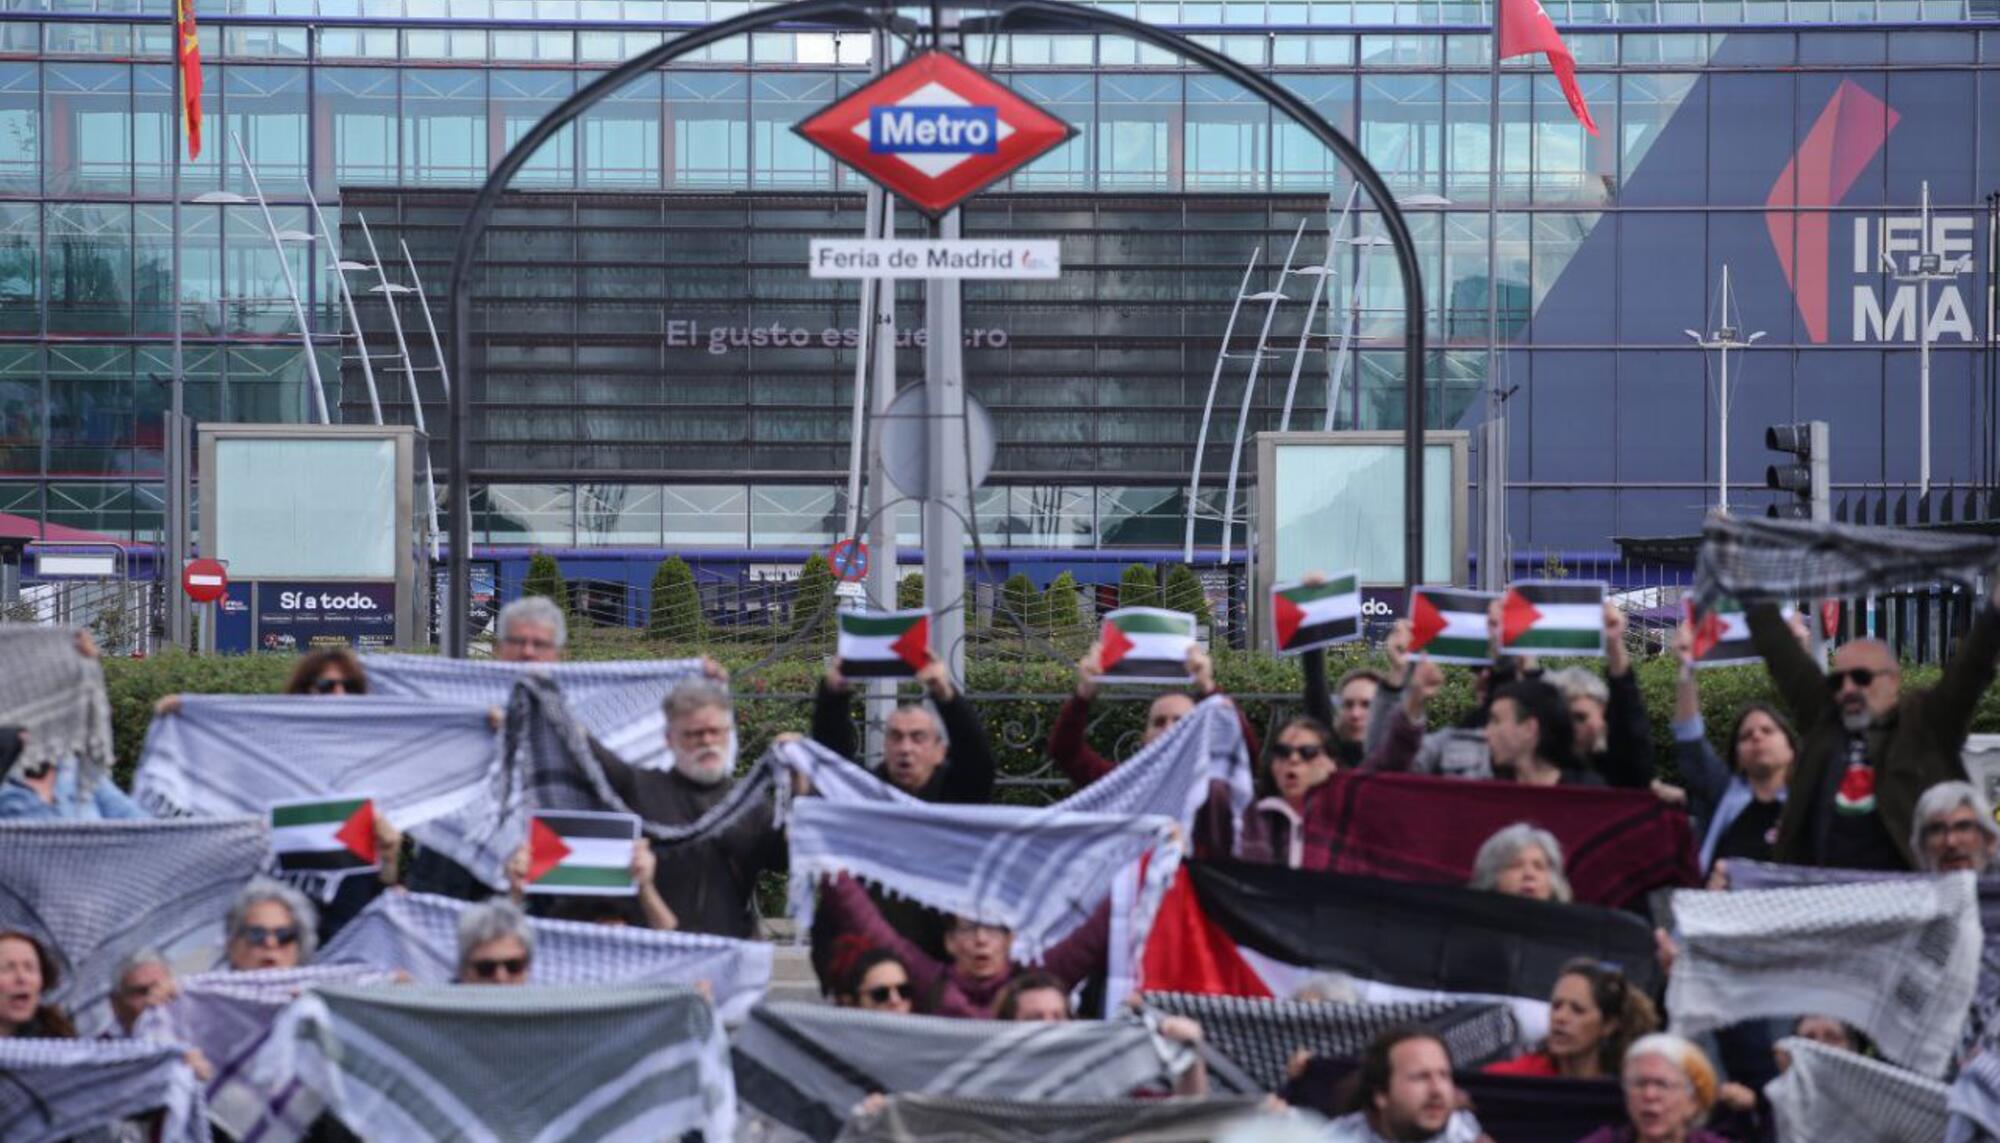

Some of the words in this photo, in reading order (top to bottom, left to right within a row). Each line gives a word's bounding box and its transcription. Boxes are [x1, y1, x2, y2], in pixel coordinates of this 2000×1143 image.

[881, 112, 988, 145] Metro
[819, 249, 879, 269] Feria
[888, 249, 918, 269] de
[927, 249, 1012, 269] Madrid
[1854, 217, 1996, 273] IFE
[1853, 285, 1996, 342] MA
[667, 320, 696, 346] El
[708, 322, 809, 354] gusto
[821, 327, 860, 347] es
[280, 591, 303, 609] Sí
[304, 597, 316, 609] a
[320, 592, 378, 609] todo.
[1362, 598, 1393, 615] do.
